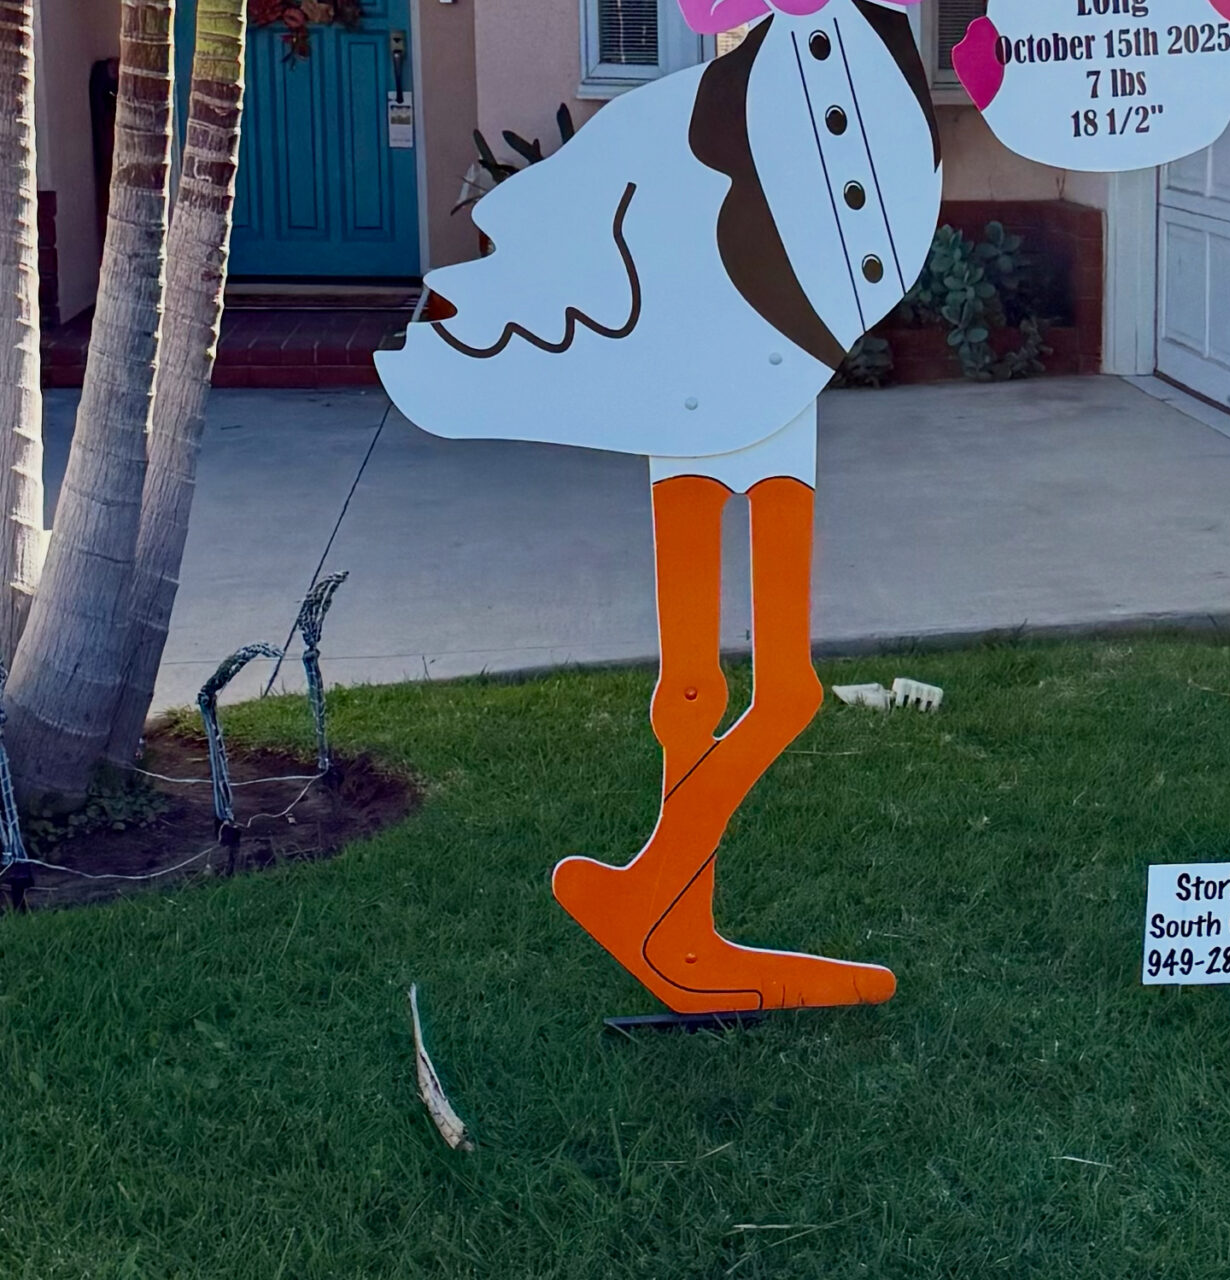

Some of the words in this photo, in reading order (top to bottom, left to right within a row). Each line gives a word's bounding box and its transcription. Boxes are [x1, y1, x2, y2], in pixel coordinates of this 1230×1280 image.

[994, 32, 1095, 66] October
[1103, 27, 1159, 59] 15th
[1086, 70, 1102, 98] 7
[1110, 68, 1147, 97] lbs
[1070, 109, 1098, 137] 18
[1106, 104, 1164, 136] 1/2"
[1149, 911, 1221, 939] South
